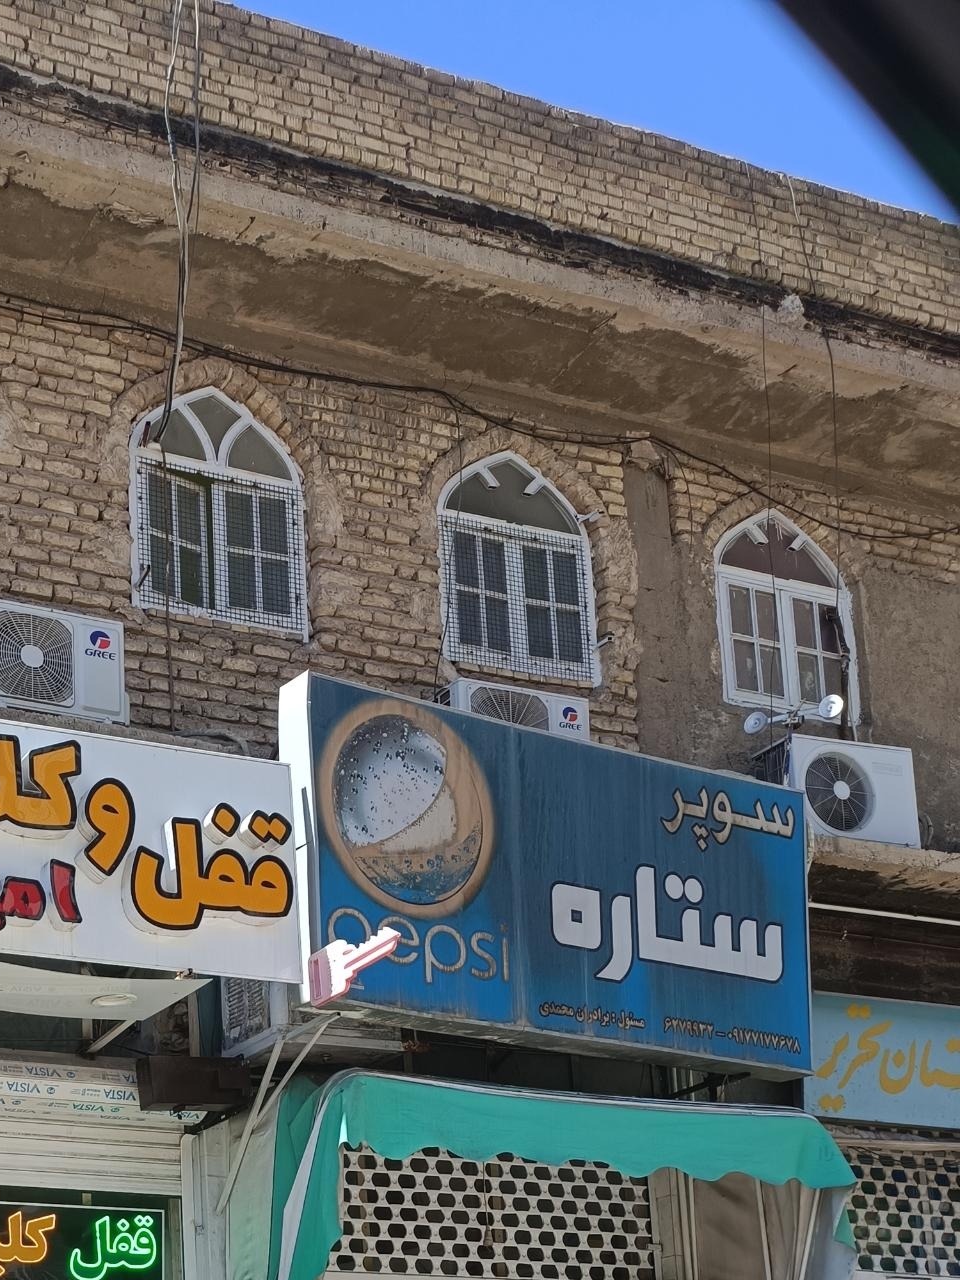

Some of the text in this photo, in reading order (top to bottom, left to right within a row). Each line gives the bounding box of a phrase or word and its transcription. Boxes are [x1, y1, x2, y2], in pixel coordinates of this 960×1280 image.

[85, 648, 117, 660] GREE
[559, 721, 583, 730] GREE
[84, 777, 135, 875] و
[660, 786, 795, 850] سوپر
[131, 802, 294, 931] قفل
[551, 864, 784, 984] ستاره
[539, 1001, 574, 1017] محمدی
[6, 1081, 40, 1094] VISTA
[103, 1088, 137, 1101] VISTA
